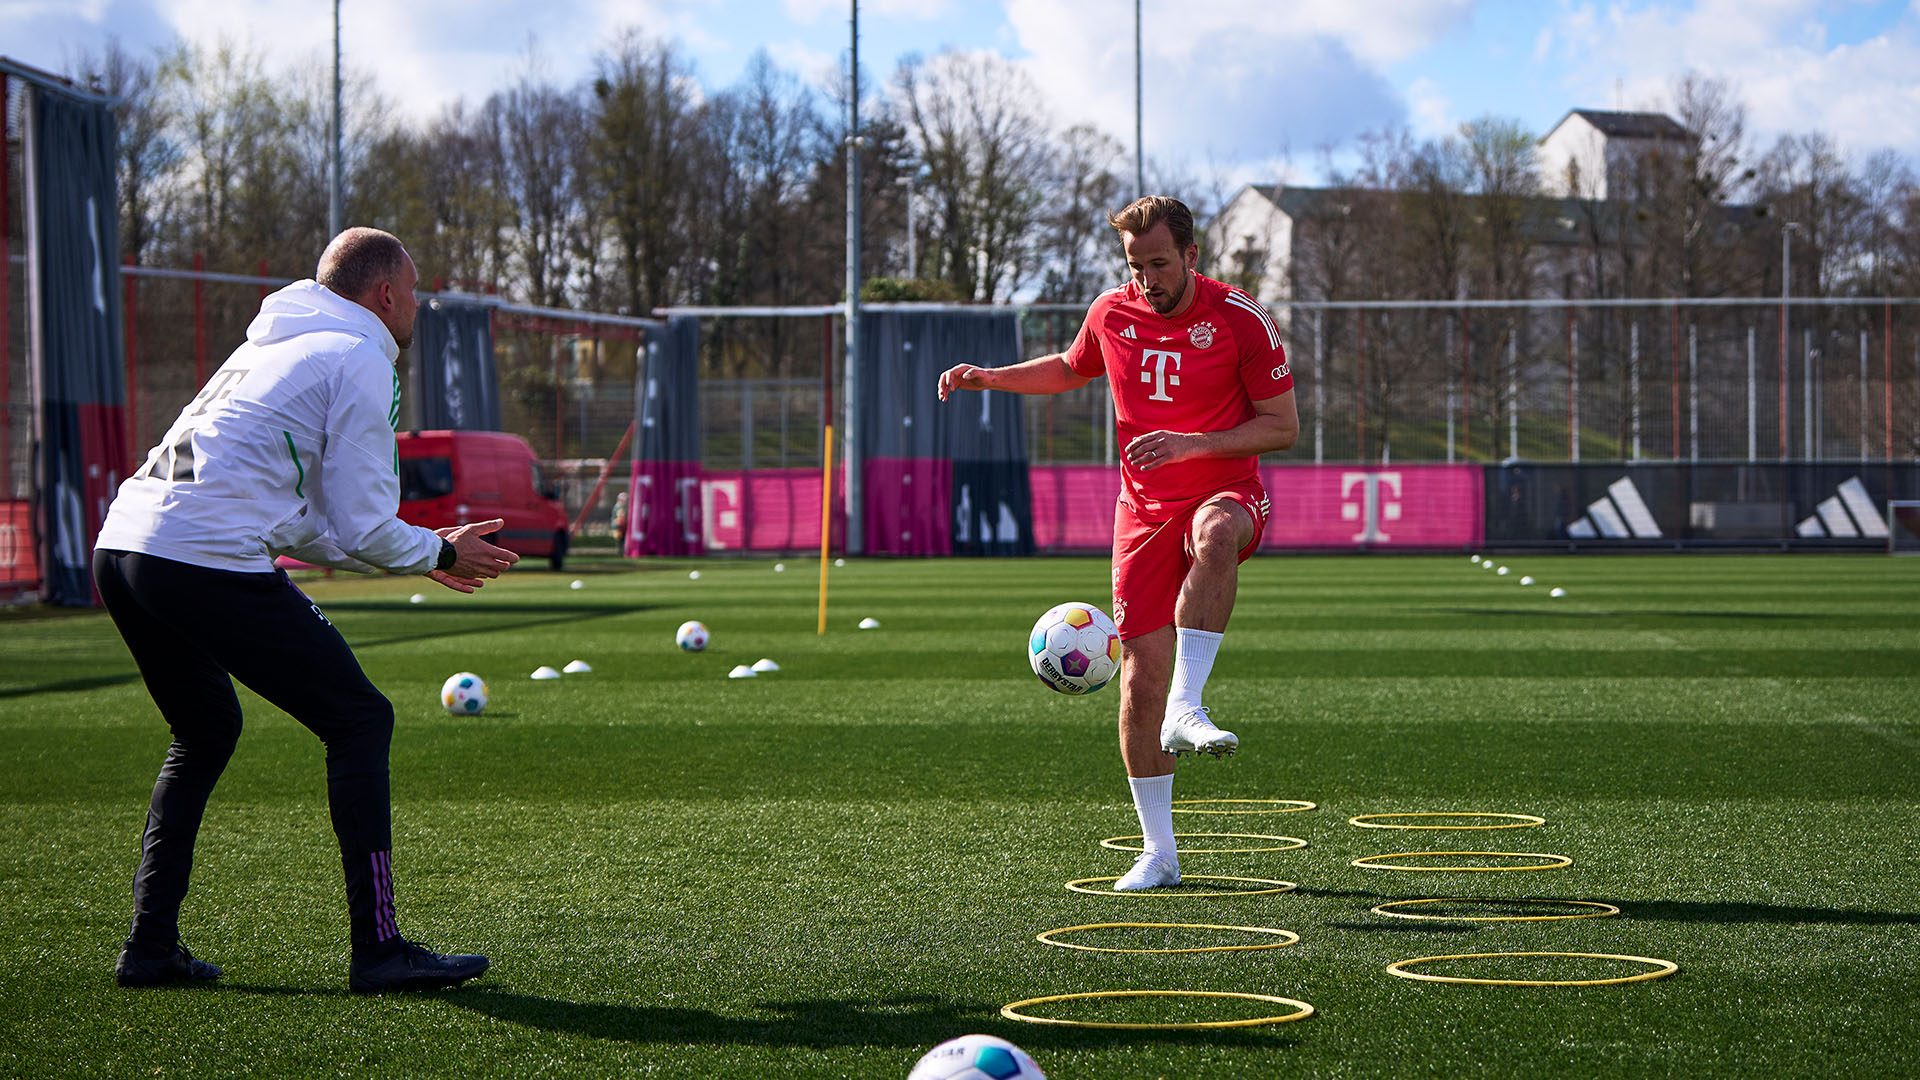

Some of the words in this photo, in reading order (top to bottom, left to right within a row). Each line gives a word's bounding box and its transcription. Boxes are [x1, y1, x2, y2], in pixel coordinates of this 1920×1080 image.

[191, 369, 250, 416] T
[1141, 349, 1181, 401] T
[1341, 472, 1402, 543] T
[1042, 657, 1083, 692] DERBYSTAR
